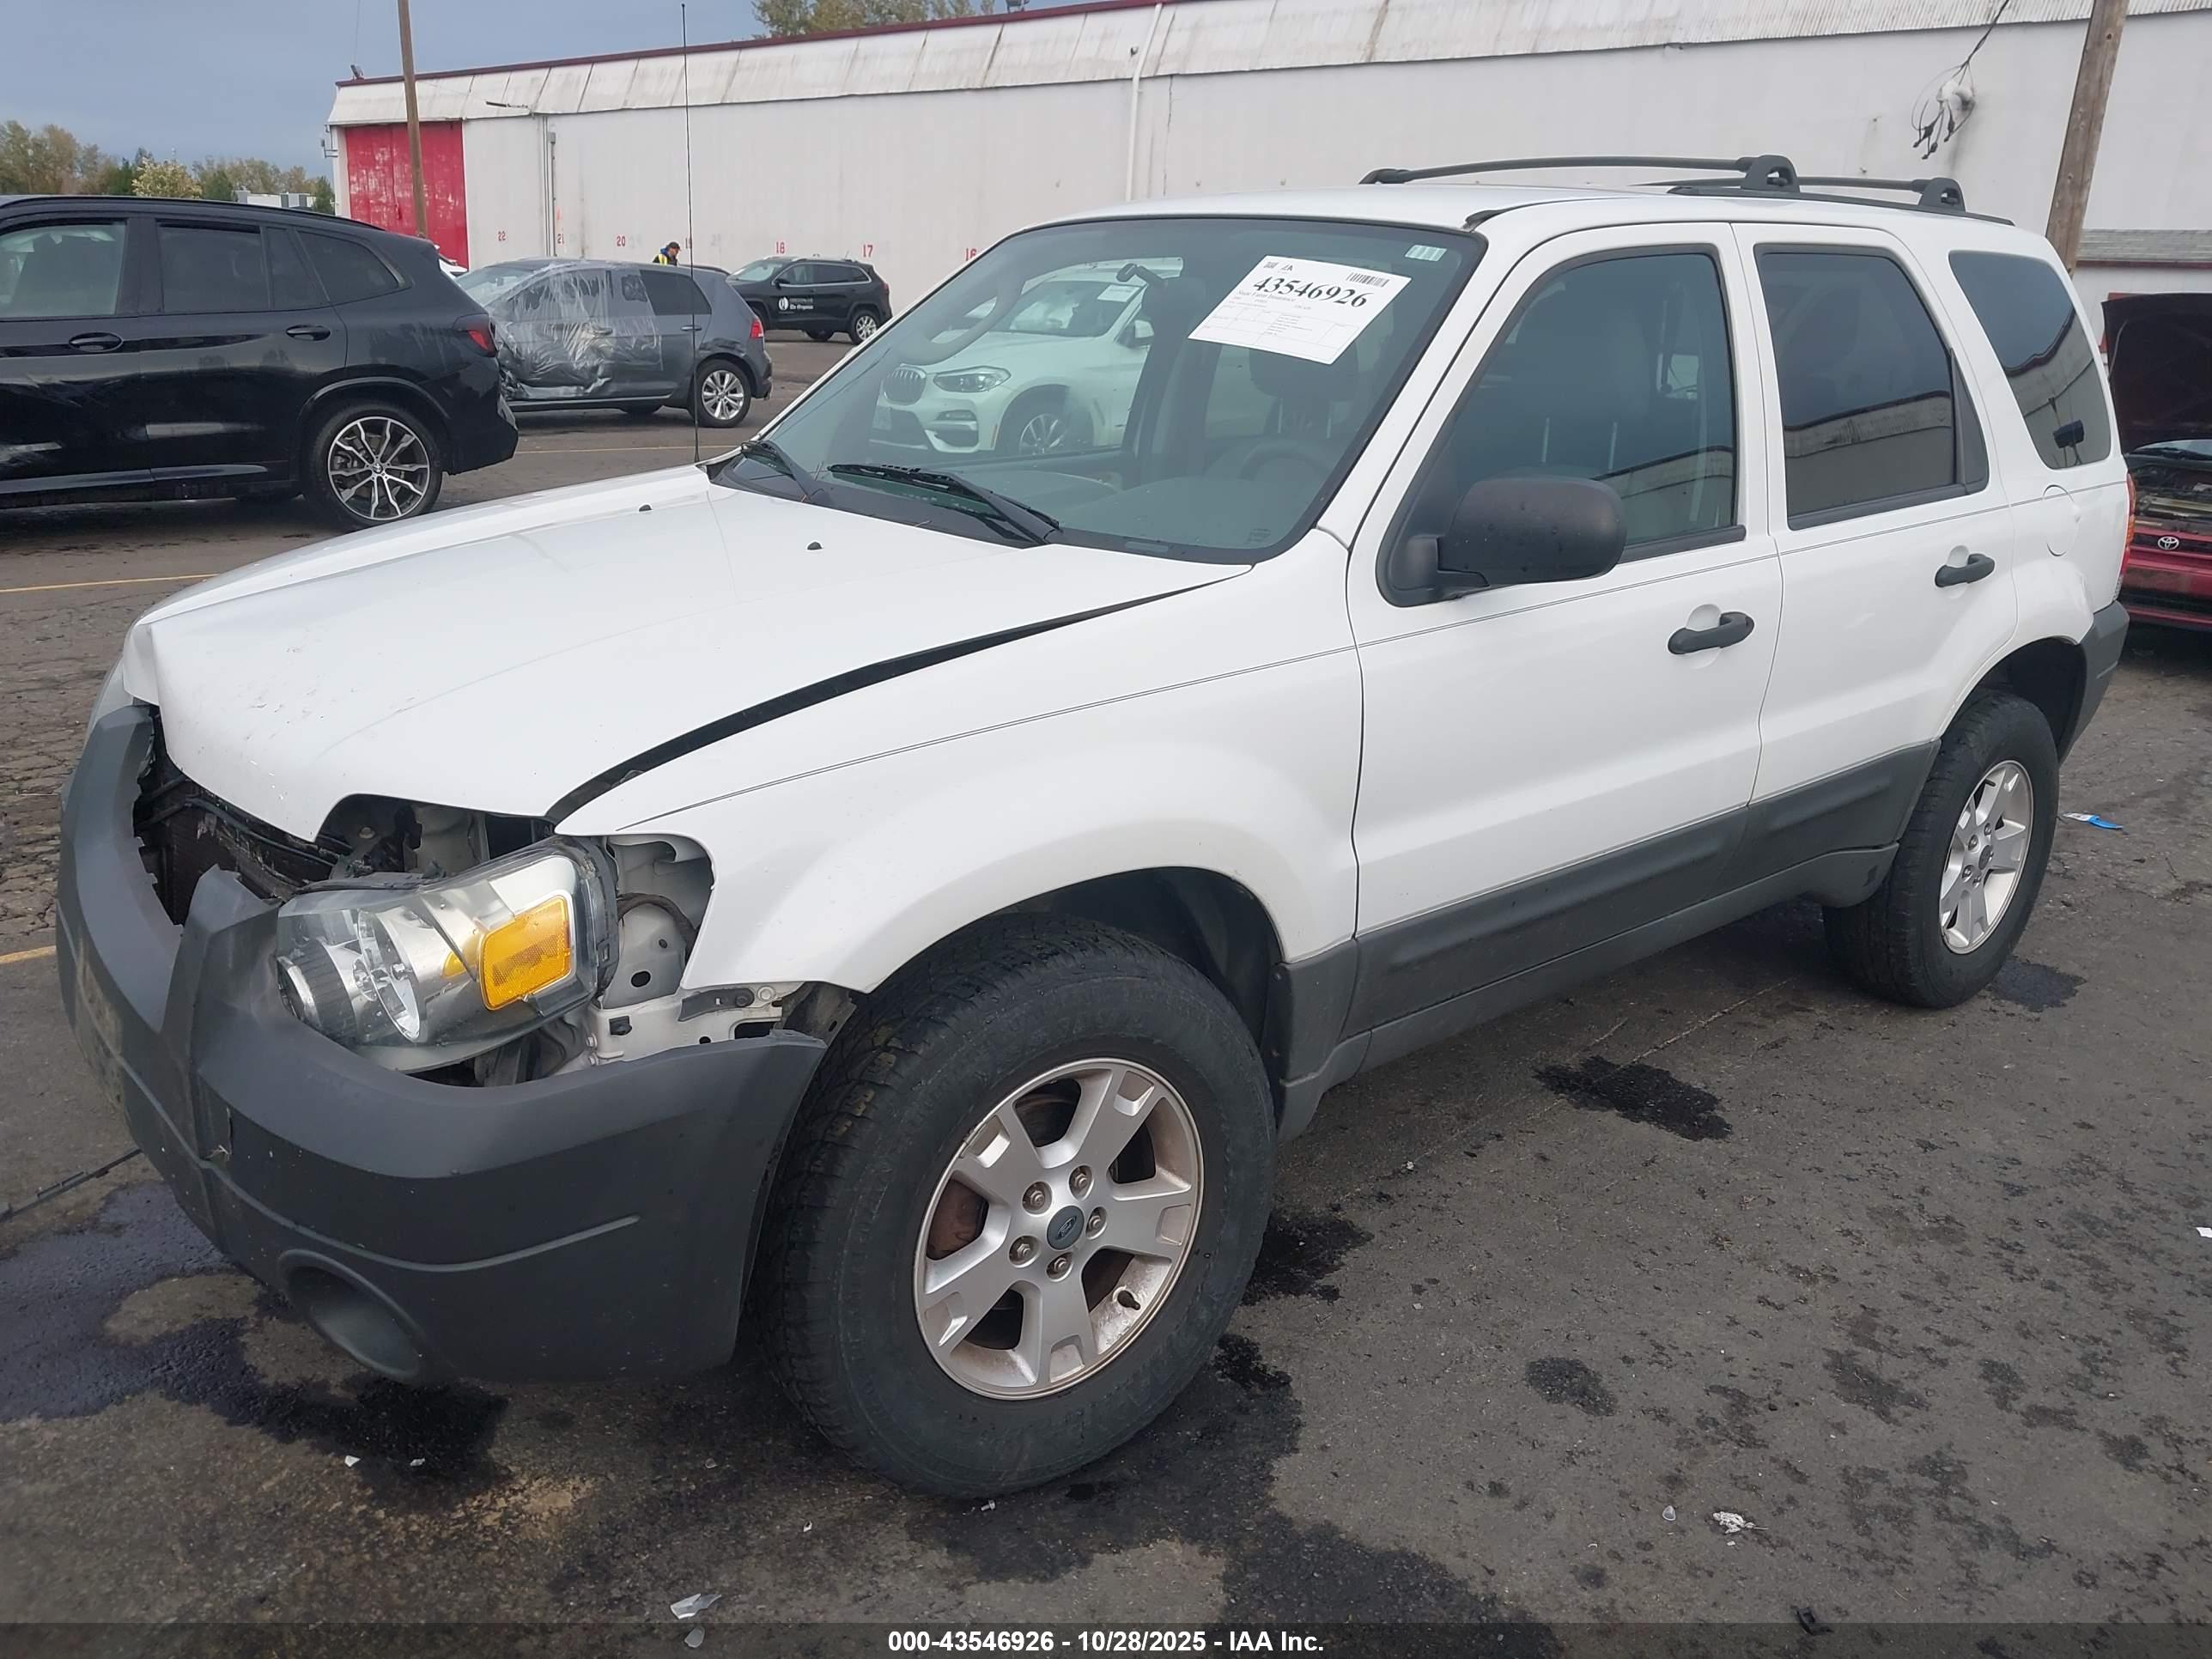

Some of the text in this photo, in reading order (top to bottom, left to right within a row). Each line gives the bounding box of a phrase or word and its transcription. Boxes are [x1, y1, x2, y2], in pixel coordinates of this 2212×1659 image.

[497, 230, 507, 242] 22
[556, 233, 564, 245] 21
[616, 235, 626, 247] 20
[775, 241, 786, 254] 18
[863, 244, 873, 258] 17
[1253, 276, 1374, 308] 43546926
